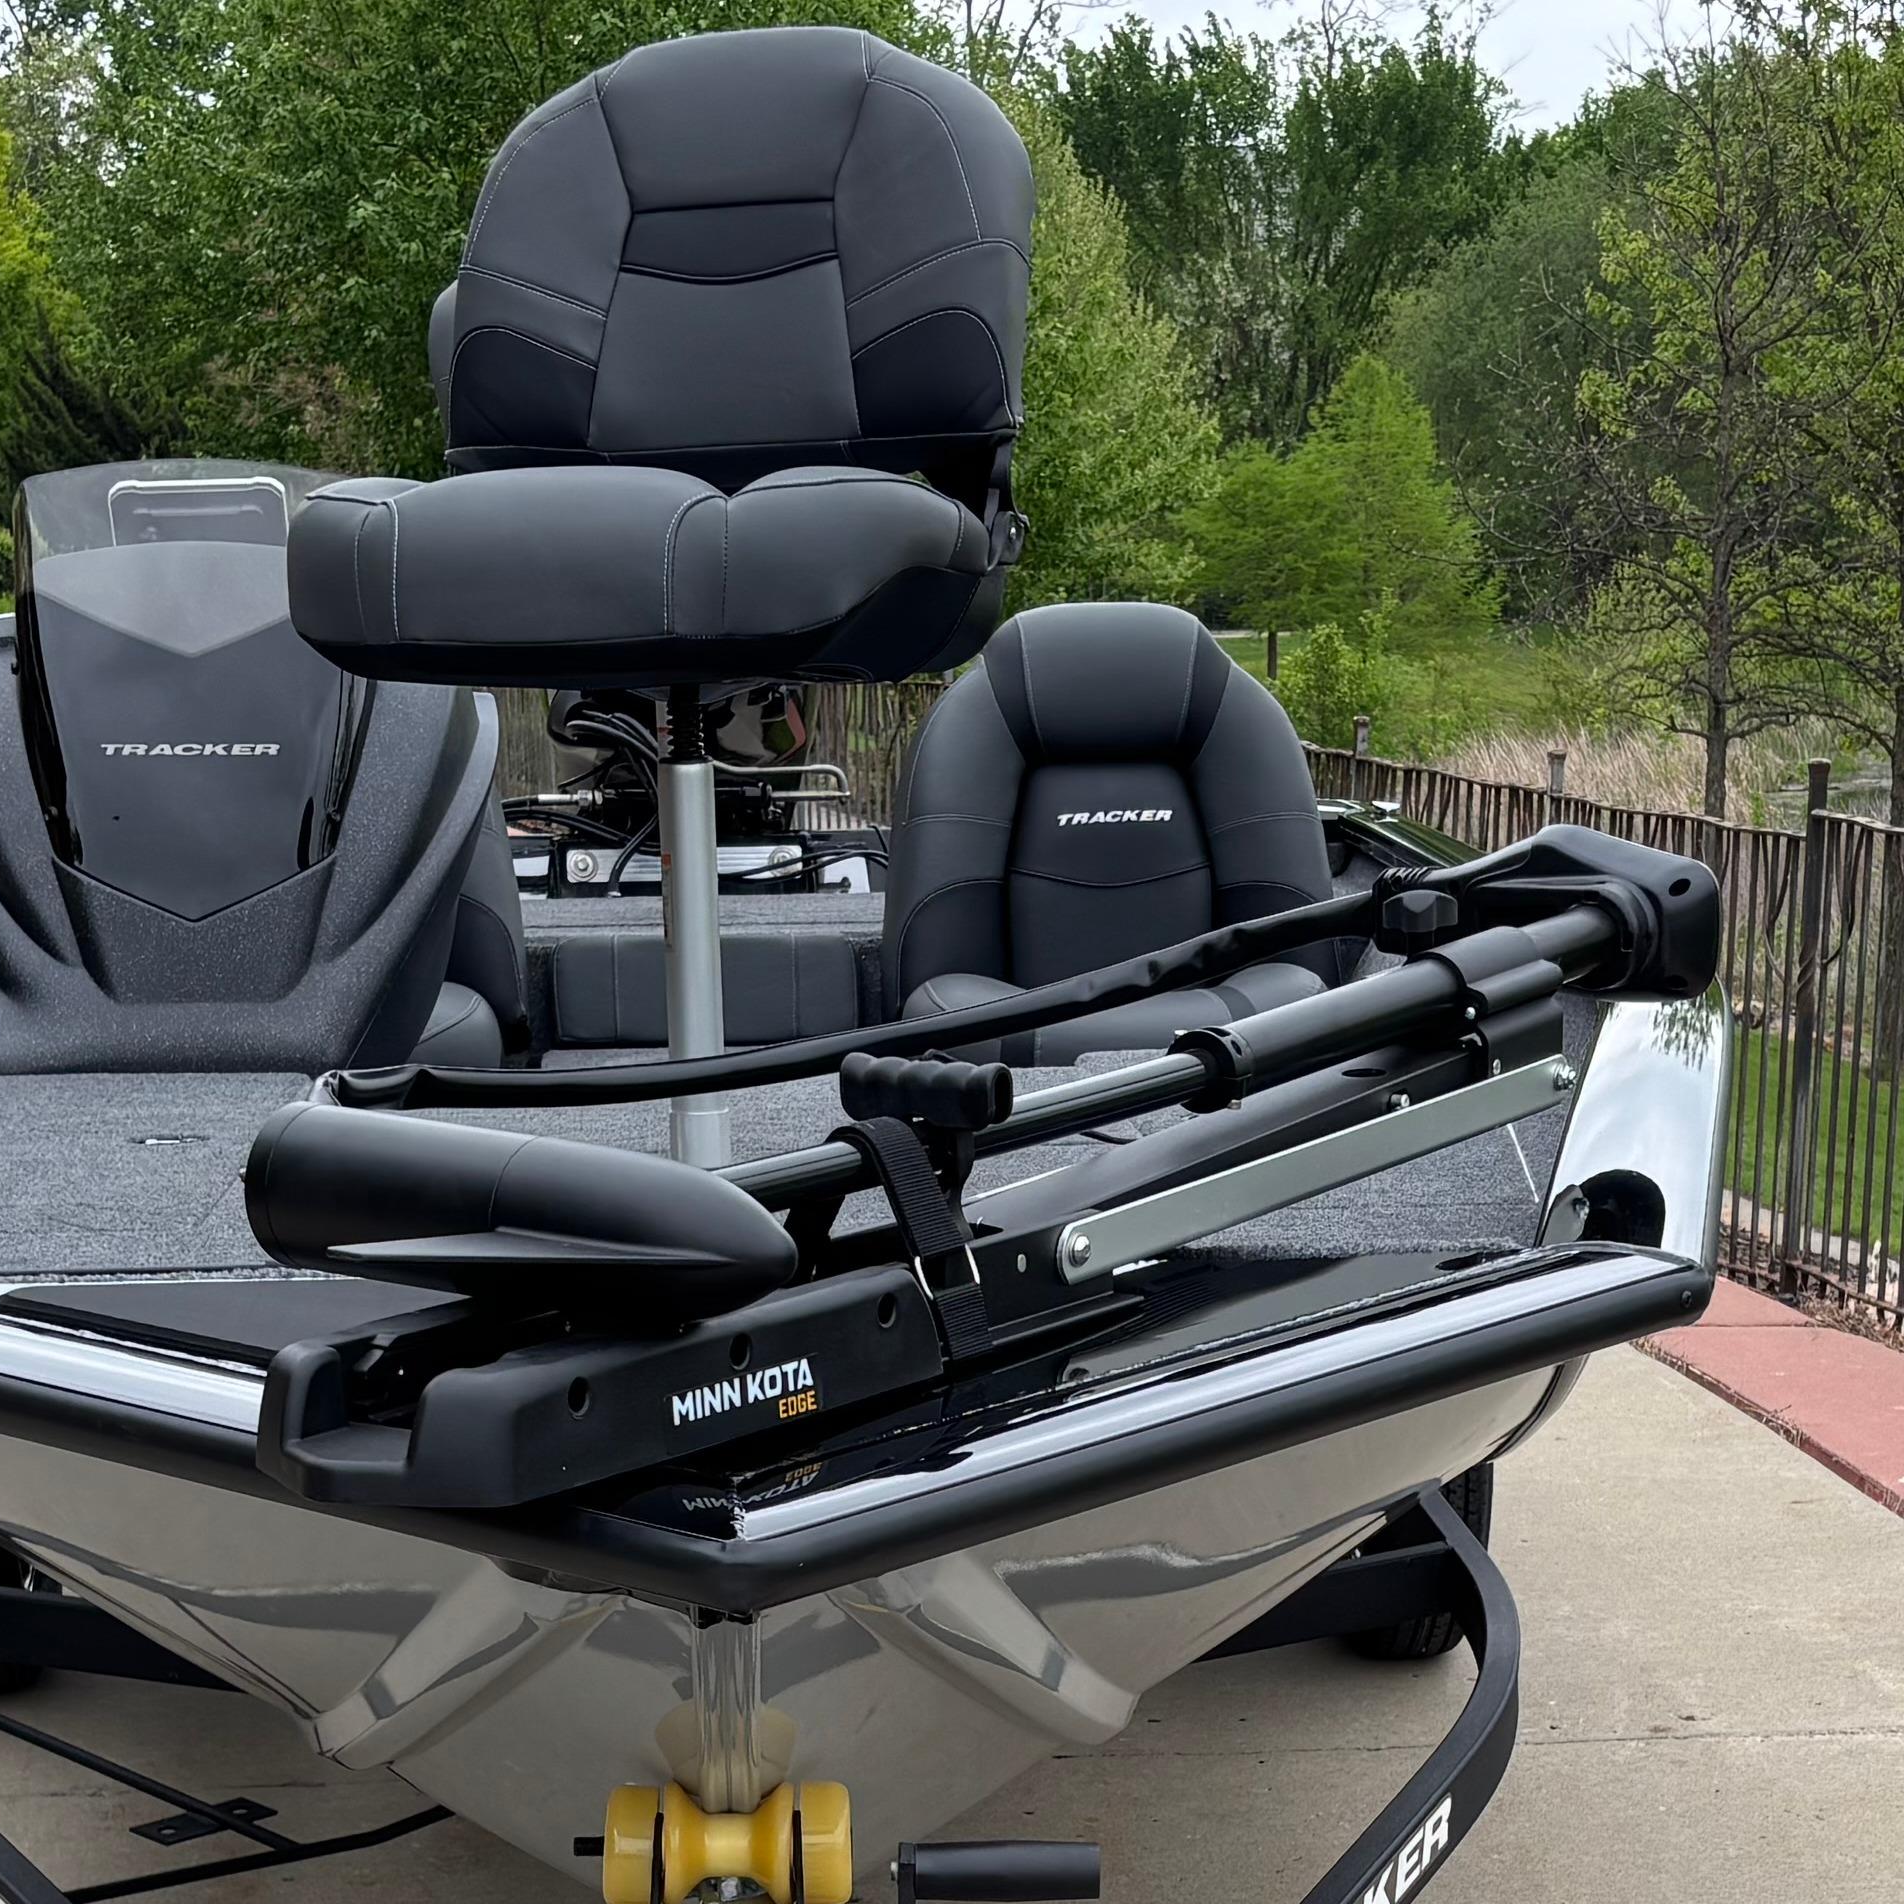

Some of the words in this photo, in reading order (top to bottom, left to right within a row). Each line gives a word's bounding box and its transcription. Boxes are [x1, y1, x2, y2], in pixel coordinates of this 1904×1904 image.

[100, 743, 281, 756] TRACKER
[1057, 809, 1173, 827] TRACKER
[671, 1377, 742, 1427] MINN
[746, 1358, 814, 1404] KOTA
[778, 1390, 817, 1419] EDGE
